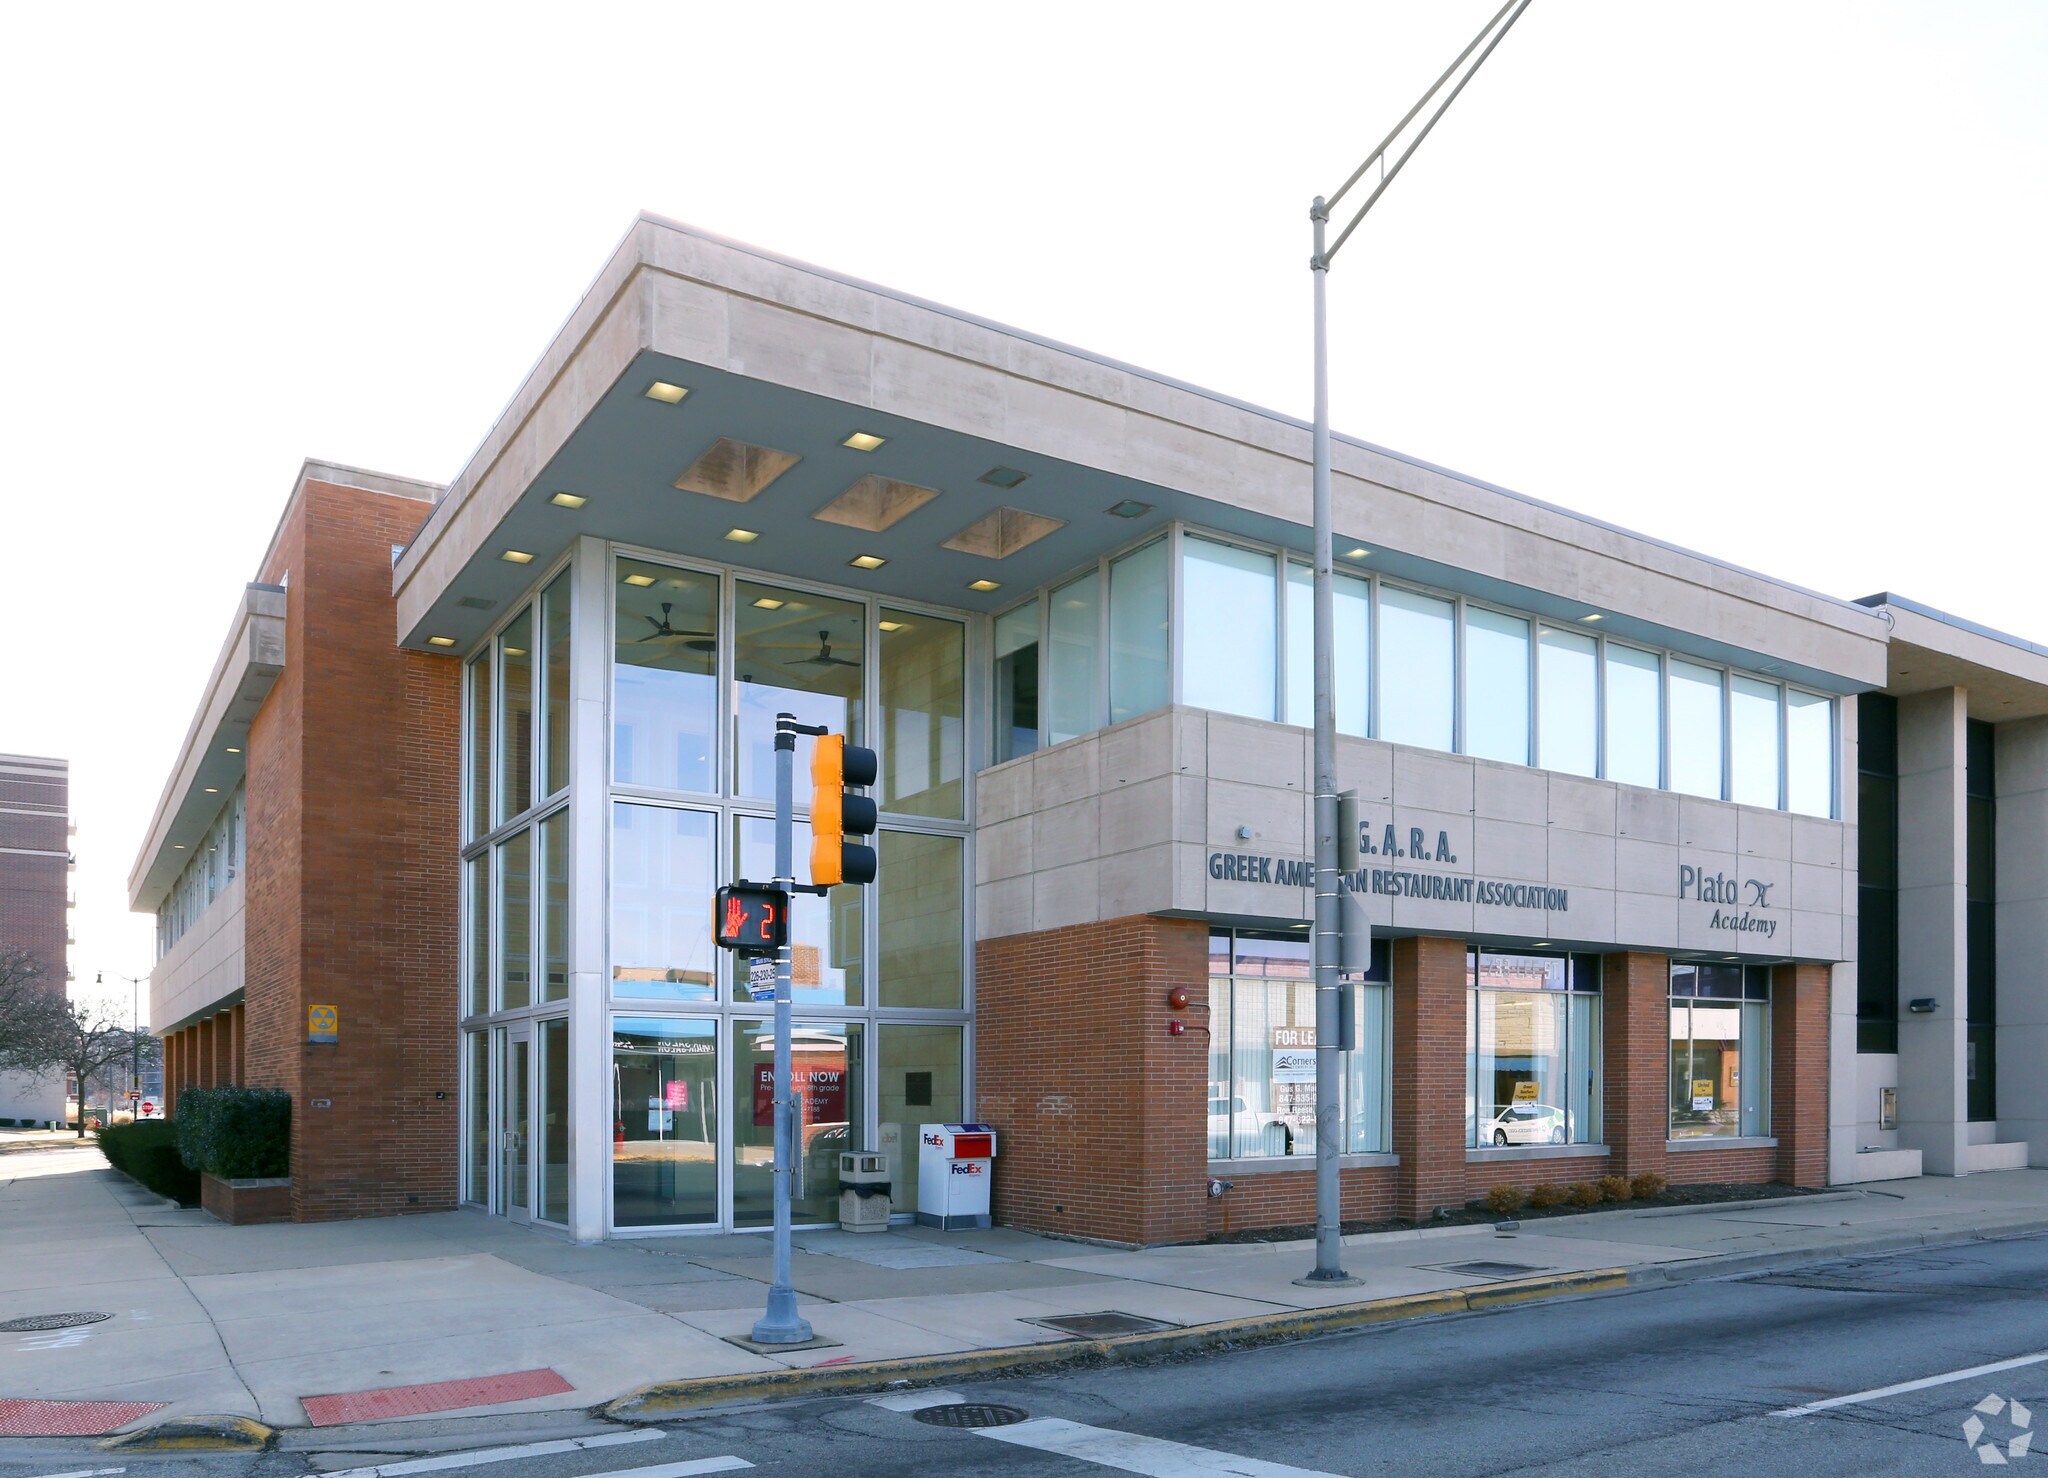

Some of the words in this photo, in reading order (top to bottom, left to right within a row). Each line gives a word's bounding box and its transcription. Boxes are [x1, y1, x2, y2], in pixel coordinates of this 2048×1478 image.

[1209, 853, 1272, 883] GREEK
[1275, 859, 1368, 893] AMEAN
[1372, 869, 1474, 902] RESTAURANT
[1476, 881, 1568, 911] ASSOCIATION
[1680, 864, 1738, 904] Plato
[1710, 908, 1777, 939] Academy
[1275, 1030, 1298, 1046] FOR
[1301, 1030, 1317, 1046] LE
[1286, 1055, 1317, 1066] Corners
[761, 1071, 806, 1082] ENLL
[809, 1071, 839, 1083] NOW
[819, 1084, 840, 1093] grade
[923, 1133, 945, 1147] FedEx
[951, 1163, 982, 1175] FedEx
